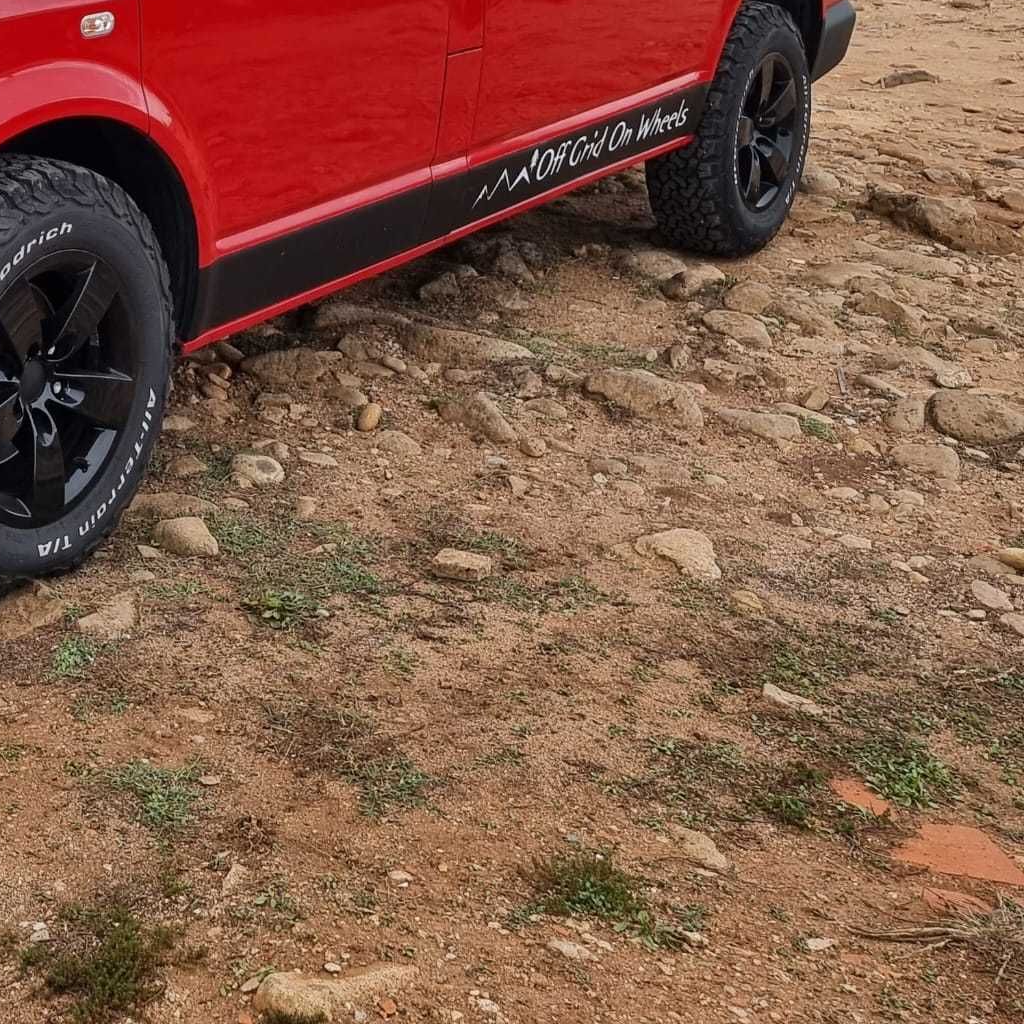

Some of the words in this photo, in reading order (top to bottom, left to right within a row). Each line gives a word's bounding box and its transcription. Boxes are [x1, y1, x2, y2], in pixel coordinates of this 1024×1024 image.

[536, 140, 572, 181] Off
[569, 125, 609, 167] Grid
[608, 121, 632, 152] On
[636, 99, 689, 142] Wheels
[37, 536, 73, 558] T/A
